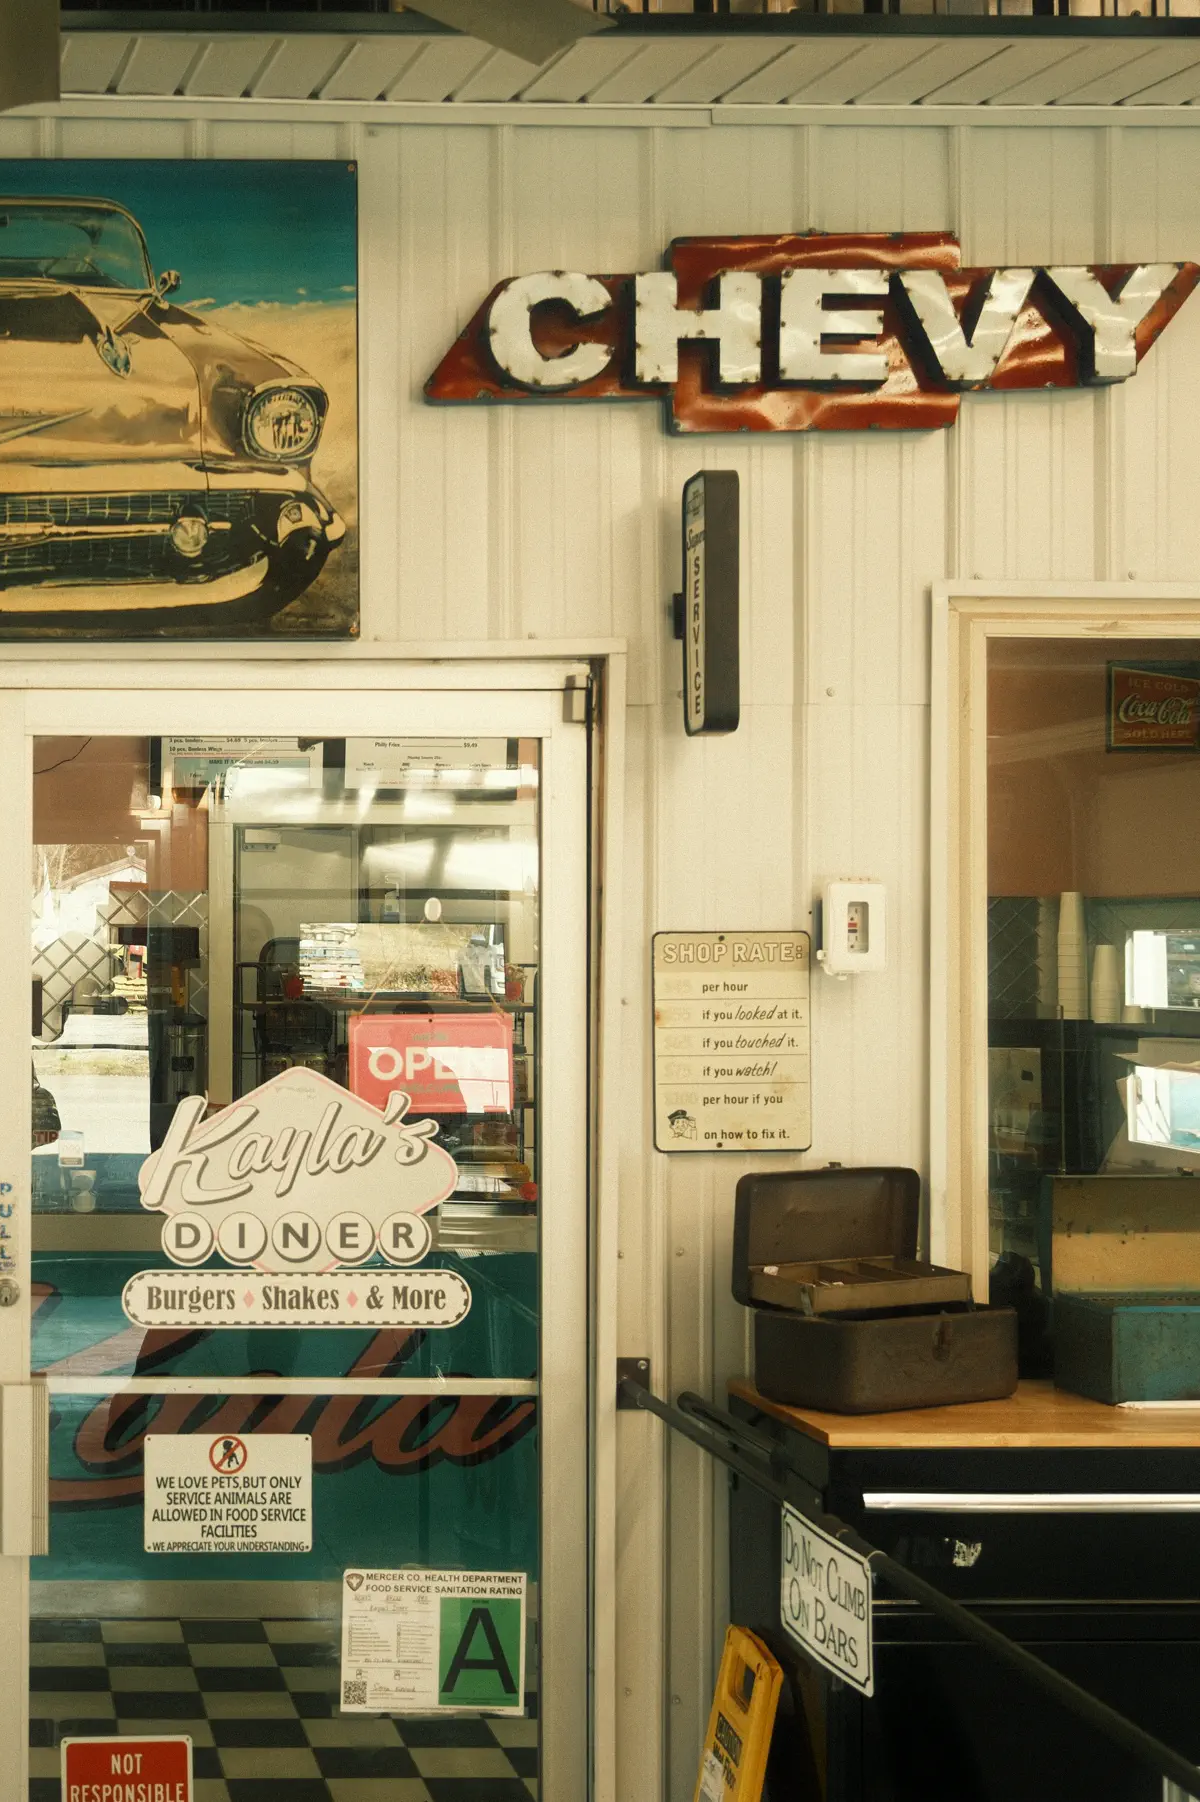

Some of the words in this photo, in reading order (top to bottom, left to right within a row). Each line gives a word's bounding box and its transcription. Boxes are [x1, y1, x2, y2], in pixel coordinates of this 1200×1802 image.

[489, 263, 1181, 385] CHEVY
[692, 556, 702, 716] SERVICE
[663, 942, 728, 964] SHOP
[732, 942, 804, 963] RATE:
[701, 983, 720, 994] per
[722, 981, 749, 992] hour
[702, 1009, 711, 1020] if
[713, 1011, 733, 1023] you
[734, 1005, 777, 1021] looked
[777, 1010, 789, 1020] at
[790, 1009, 803, 1020] it.
[702, 1037, 711, 1048] if
[713, 1040, 734, 1052] you
[734, 1033, 786, 1049] touched
[787, 1037, 799, 1048] it.
[367, 1046, 490, 1081] OPE
[702, 1065, 711, 1076] if
[713, 1068, 734, 1080] you
[735, 1061, 779, 1077] watch!
[702, 1094, 720, 1105] per
[723, 1093, 750, 1104] hour
[752, 1093, 761, 1104] if
[763, 1095, 784, 1107] you
[703, 1132, 718, 1140] on
[720, 1129, 744, 1140] how
[746, 1130, 759, 1140] to
[761, 1129, 776, 1140] fix
[778, 1129, 791, 1140] it.
[141, 1090, 440, 1207] Kayla's
[173, 1221, 416, 1250] DINER
[146, 1285, 236, 1313] Burgers
[261, 1285, 341, 1311] Shakes
[365, 1285, 384, 1311] &
[391, 1285, 447, 1311] More
[155, 1476, 176, 1489] WE
[178, 1476, 209, 1489] LOVE
[269, 1476, 302, 1489] ONLY
[166, 1492, 212, 1506] SERVICE
[213, 1492, 267, 1506] ANIMALS
[269, 1492, 293, 1506] ARE
[152, 1508, 208, 1522] ALLOWED
[210, 1508, 223, 1522] IN
[225, 1508, 259, 1522] FOOD
[260, 1508, 307, 1522] SERVICE
[201, 1524, 258, 1538] FACILITIES
[152, 1541, 166, 1552] WE
[167, 1541, 212, 1552] APPRECIATE
[213, 1541, 236, 1552] YOUR
[236, 1541, 305, 1552] UNDERSTANDING
[365, 1572, 405, 1582] MERCER
[407, 1573, 422, 1582] CO.
[424, 1574, 461, 1583] HEALTH
[462, 1575, 523, 1584] DEPARTMENT
[365, 1584, 392, 1593] FOOD
[393, 1585, 432, 1593] SERVICE
[434, 1586, 488, 1595] SANITATION
[489, 1587, 523, 1596] RATING
[440, 1607, 518, 1694] A
[110, 1753, 143, 1775] NOT
[70, 1783, 185, 1802] RESPONSIBLE
